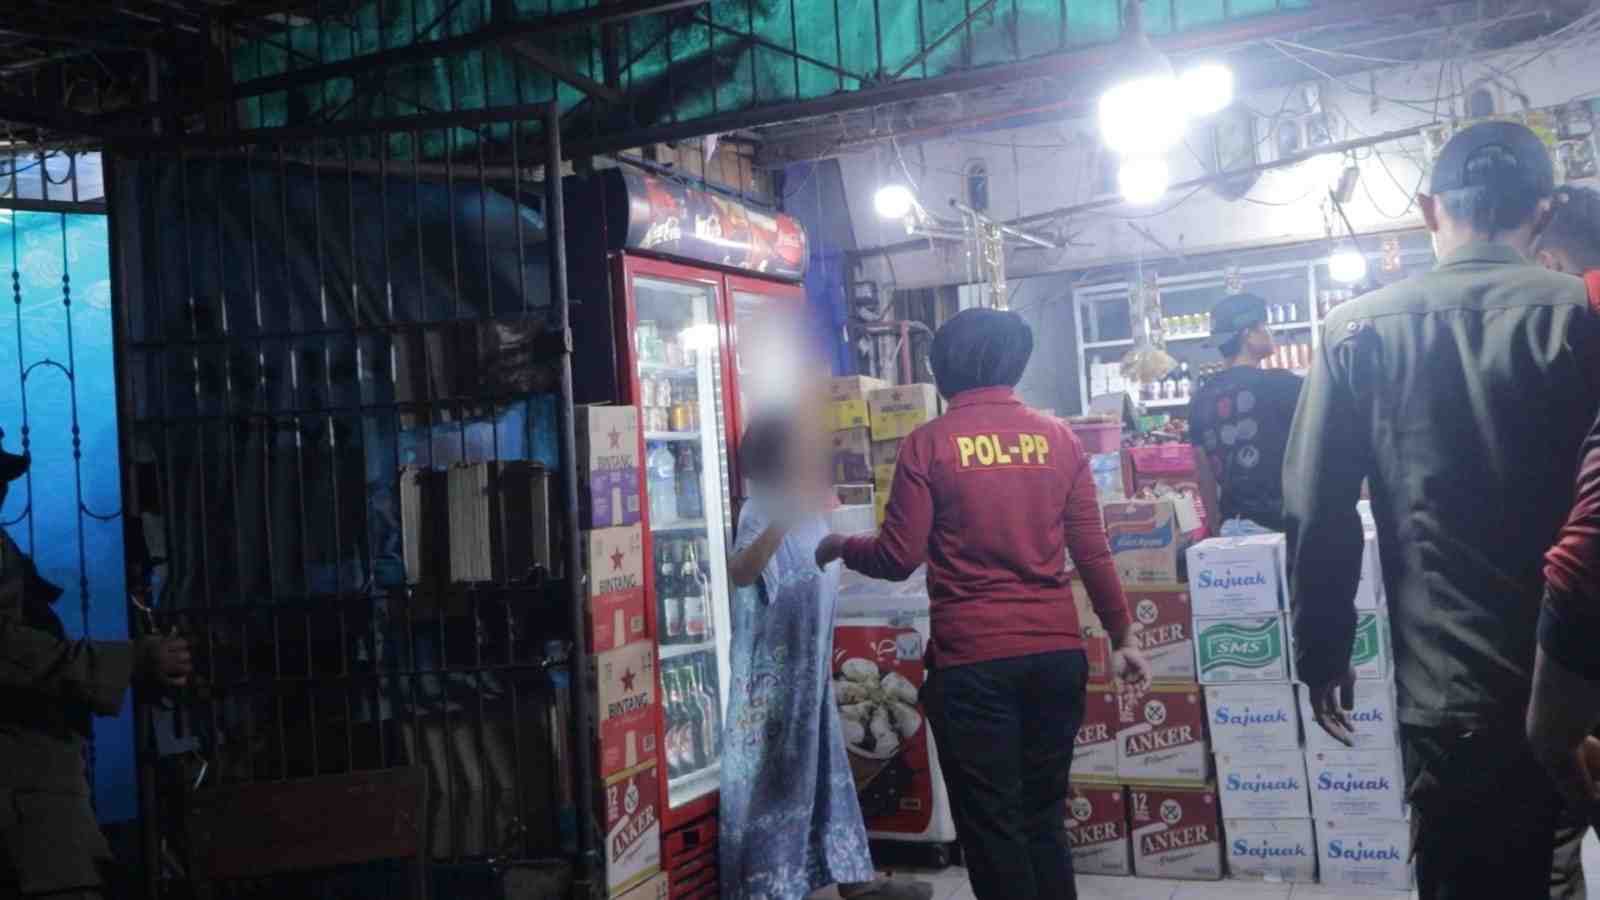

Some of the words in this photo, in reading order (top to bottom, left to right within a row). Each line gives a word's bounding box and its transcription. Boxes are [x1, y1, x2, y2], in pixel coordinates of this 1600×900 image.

[956, 433, 1048, 467] POL-PP
[599, 573, 637, 592] BINTANG
[1198, 568, 1267, 589] Sajuak
[1136, 624, 1184, 652] NKER
[1216, 640, 1261, 654] SMS
[608, 692, 649, 720] BINTANG
[1215, 706, 1289, 727] Sajuak
[1074, 723, 1109, 745] KER
[1125, 725, 1193, 754] ANKER
[1225, 772, 1300, 792] Sajuak
[1317, 770, 1390, 793] Sajuak
[1131, 793, 1149, 810] 12
[612, 804, 656, 859] ANKER
[1070, 821, 1118, 845] NKER
[1142, 825, 1209, 853] ANKER
[1231, 838, 1308, 860] Sajuak
[1327, 839, 1401, 862] Sajuak
